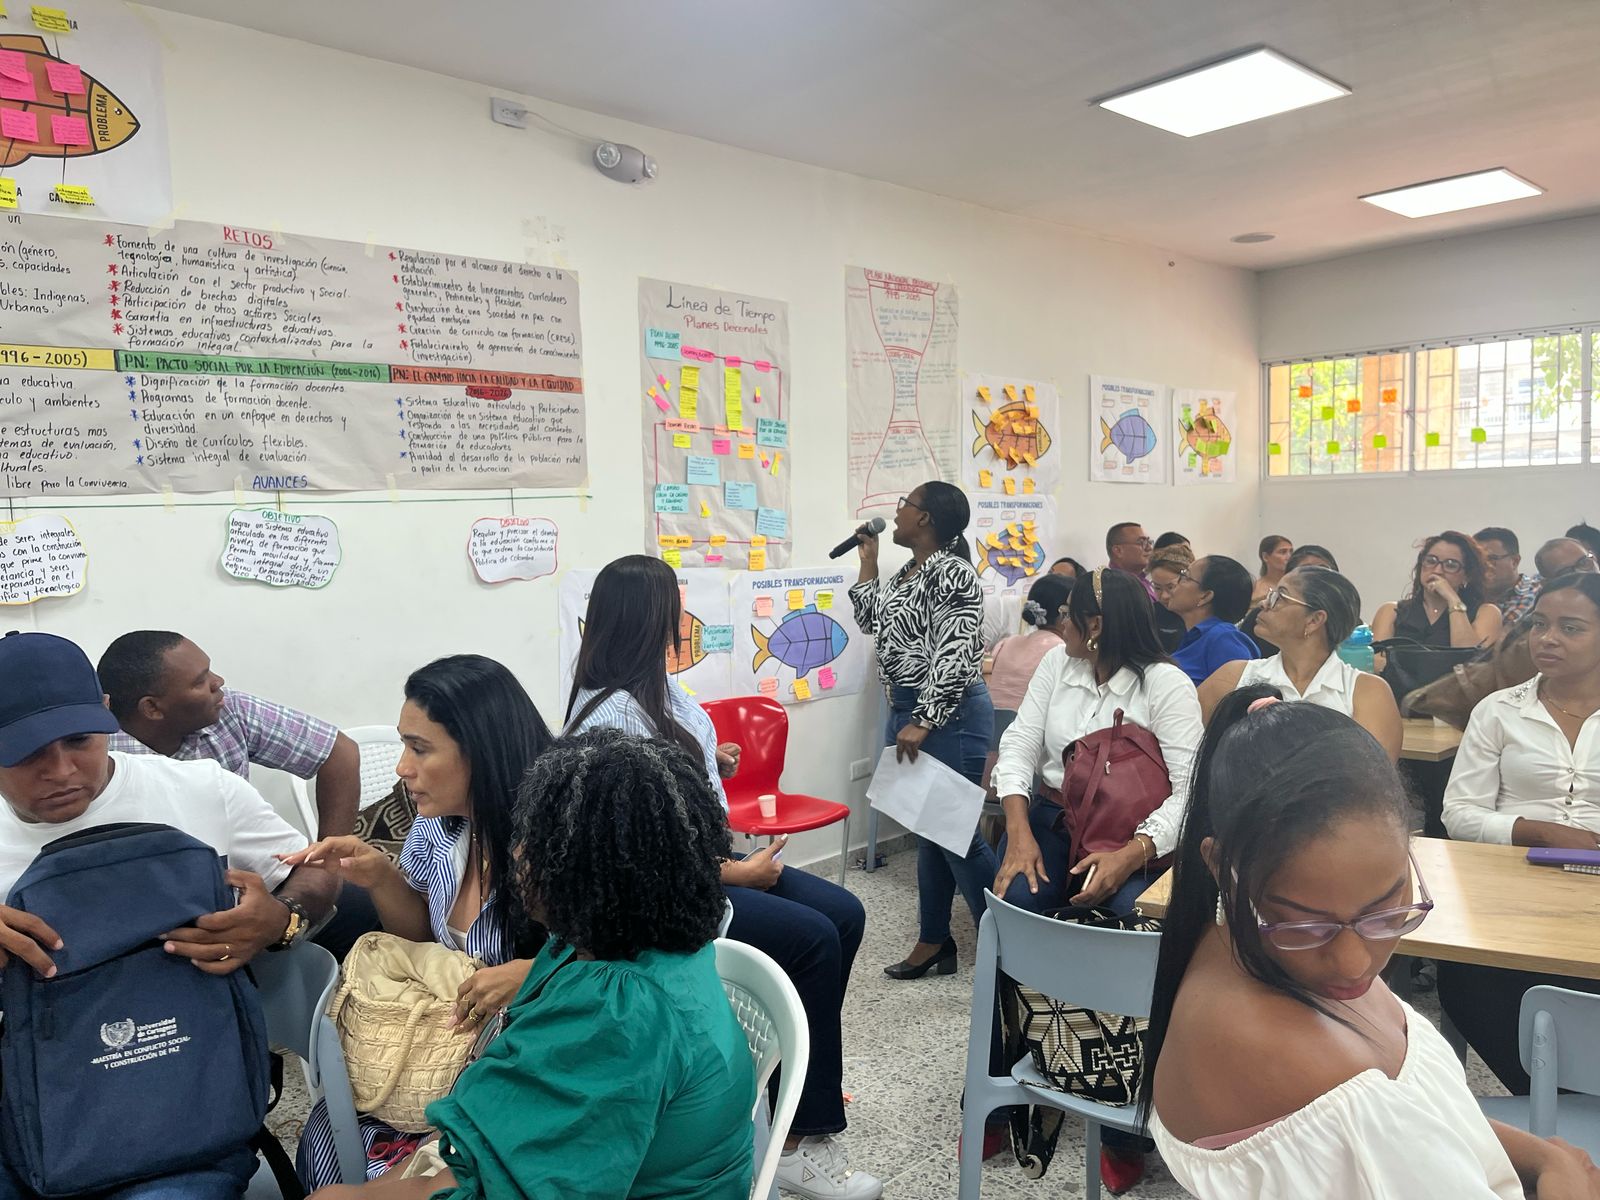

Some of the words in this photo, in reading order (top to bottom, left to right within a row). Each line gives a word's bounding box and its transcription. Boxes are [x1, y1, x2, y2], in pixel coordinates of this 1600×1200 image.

[95, 93, 111, 142] PROBLEMA
[8, 215, 21, 224] un
[223, 226, 273, 250] RETOS
[116, 234, 156, 251] Fomento
[164, 240, 176, 253] de
[183, 245, 199, 254] una
[244, 250, 256, 261] de
[12, 260, 71, 274] capacidades
[243, 265, 250, 281] y
[121, 265, 179, 281] Articulación
[188, 275, 206, 286] con
[212, 278, 221, 288] el
[262, 282, 305, 296] productivo
[310, 288, 316, 302] y
[123, 280, 170, 296] Reducción
[180, 287, 192, 297] de
[194, 301, 207, 312] de
[214, 303, 237, 315] otros
[714, 297, 732, 316] de
[736, 300, 776, 325] Tiempo
[179, 315, 193, 323] en
[683, 315, 719, 330] Planes
[724, 321, 768, 335] Decenales
[127, 325, 174, 338] Sistemas
[330, 340, 353, 351] para
[362, 340, 374, 349] la
[156, 358, 188, 371] PACTO
[195, 360, 231, 373] SOCIAL
[235, 361, 254, 374] POR
[259, 363, 272, 375] LA
[141, 374, 210, 393] Dignificación
[234, 378, 245, 388] la
[250, 381, 299, 396] formación
[29, 396, 36, 412] y
[44, 393, 101, 409] ambientes
[141, 389, 194, 408] Programas
[205, 392, 217, 403] de
[142, 409, 195, 421] Educación
[205, 412, 217, 420] en
[221, 411, 234, 419] un
[240, 409, 276, 429] enfoque
[281, 415, 290, 423] en
[295, 412, 333, 424] derechos
[341, 416, 347, 432] y
[14, 422, 80, 437] estructuras
[41, 438, 54, 449] de
[185, 438, 198, 448] de
[147, 454, 186, 467] Sistema
[193, 450, 230, 467] integral
[239, 450, 250, 461] de
[7, 475, 31, 489] libre
[65, 477, 75, 487] la
[252, 475, 308, 489] AVANCES
[977, 501, 999, 509] POSIBLES
[261, 510, 301, 523] OBJETIVO
[31, 544, 40, 553] la
[40, 568, 46, 579] y
[66, 571, 74, 579] el
[752, 580, 782, 590] POSIBLES
[784, 575, 844, 587] TRANSFORMACIONES
[23, 591, 31, 601] y
[137, 1017, 176, 1031] Universidad
[146, 1024, 177, 1035] Cartagena
[134, 1041, 167, 1054] CONFLICTO
[110, 1052, 158, 1068] CONSTRUCCIÓN
[168, 1046, 180, 1054] PAZ
